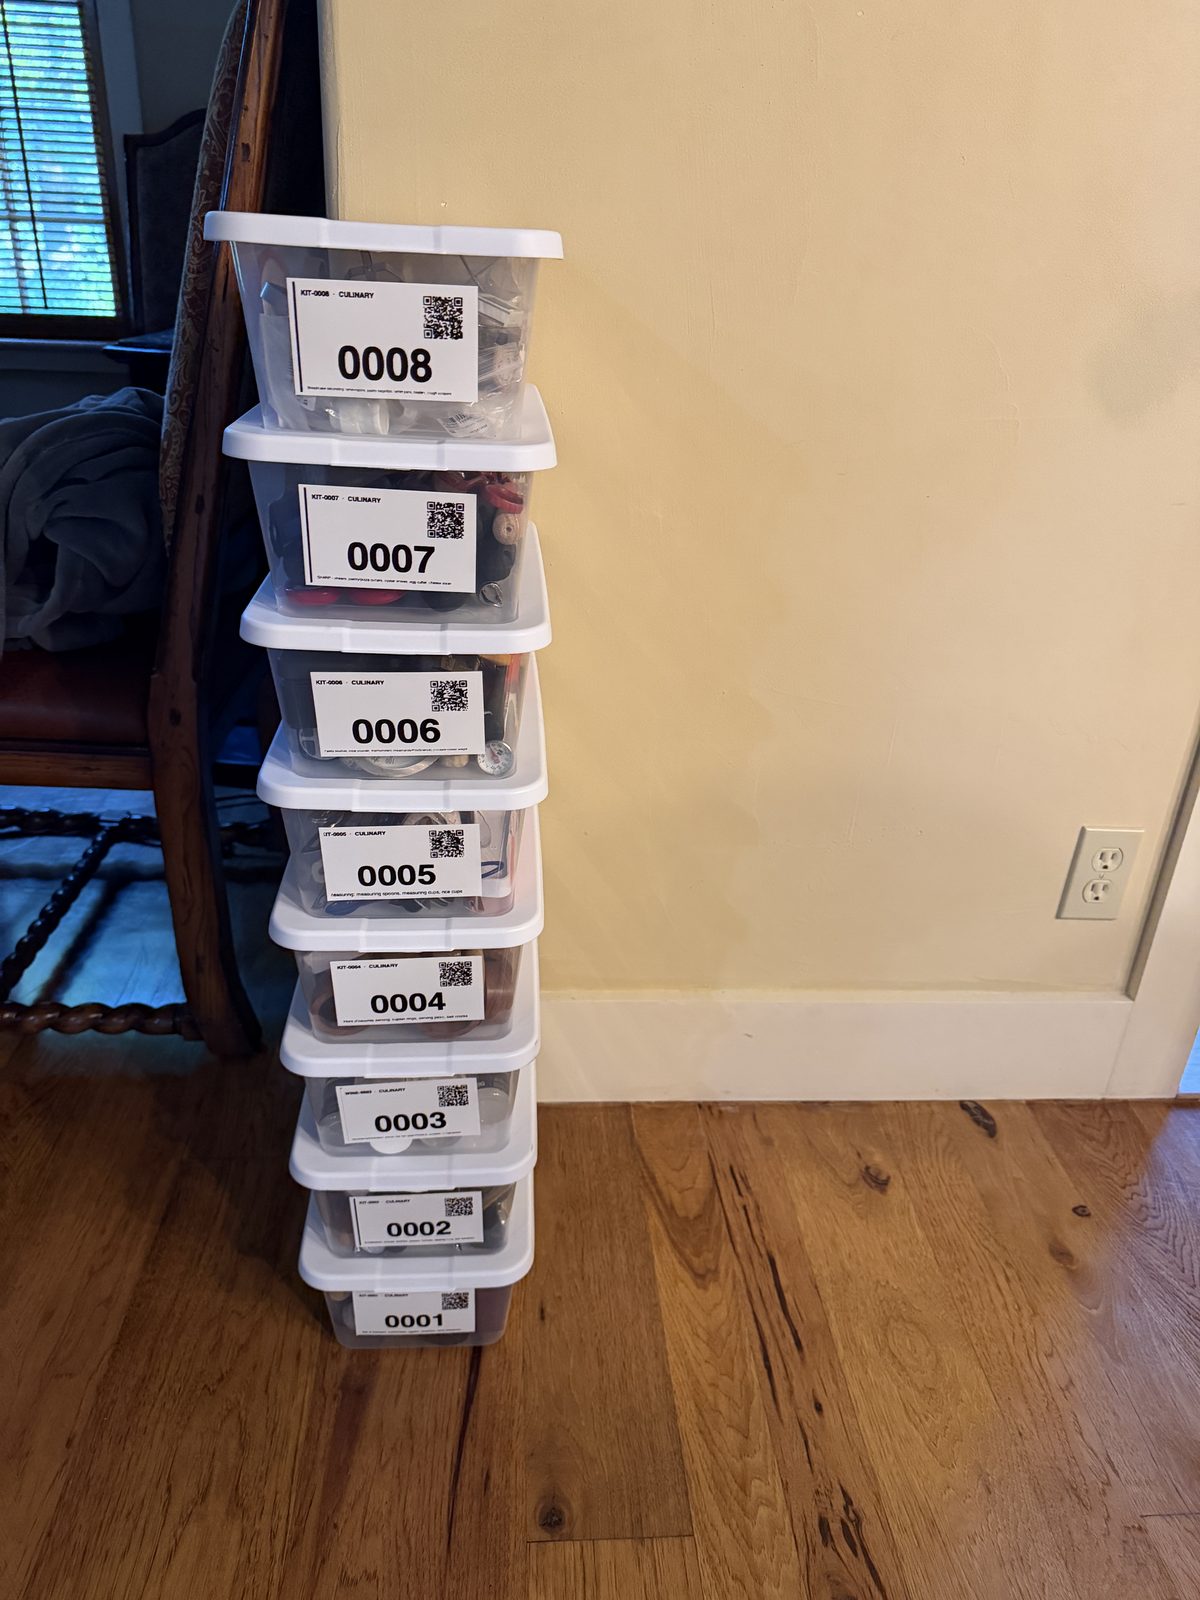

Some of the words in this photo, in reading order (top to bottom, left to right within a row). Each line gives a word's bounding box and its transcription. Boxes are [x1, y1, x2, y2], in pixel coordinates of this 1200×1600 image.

[300, 289, 330, 297] KIT-0008
[338, 291, 375, 299] CULINARY
[338, 344, 433, 383] 0008
[311, 493, 340, 501] KIT-0007
[347, 495, 382, 503] CULINARY
[347, 541, 436, 574] 0007
[351, 718, 441, 745] 0006
[357, 863, 437, 887] 0005
[370, 991, 447, 1014] 0004
[374, 1111, 447, 1133] 0003
[386, 1220, 452, 1237] 0002
[385, 1313, 443, 1329] 0001
